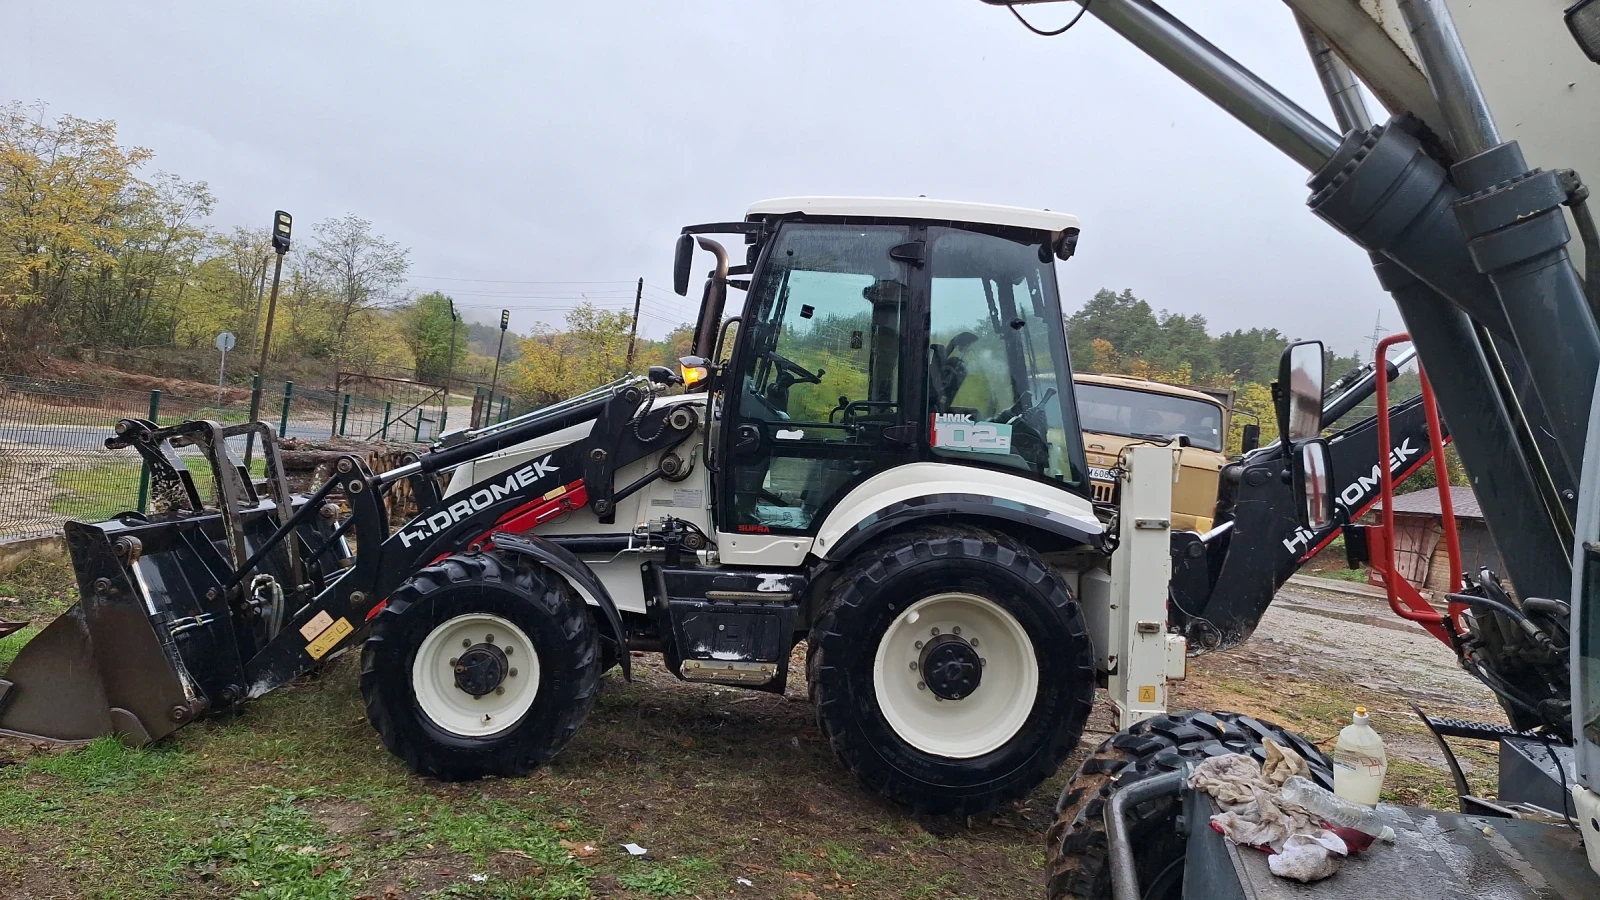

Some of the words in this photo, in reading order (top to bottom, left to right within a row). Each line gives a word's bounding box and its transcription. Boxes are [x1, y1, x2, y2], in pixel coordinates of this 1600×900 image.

[936, 412, 973, 424] HMK
[1282, 437, 1420, 555] HIOMEK
[737, 524, 771, 534] SUPRA
